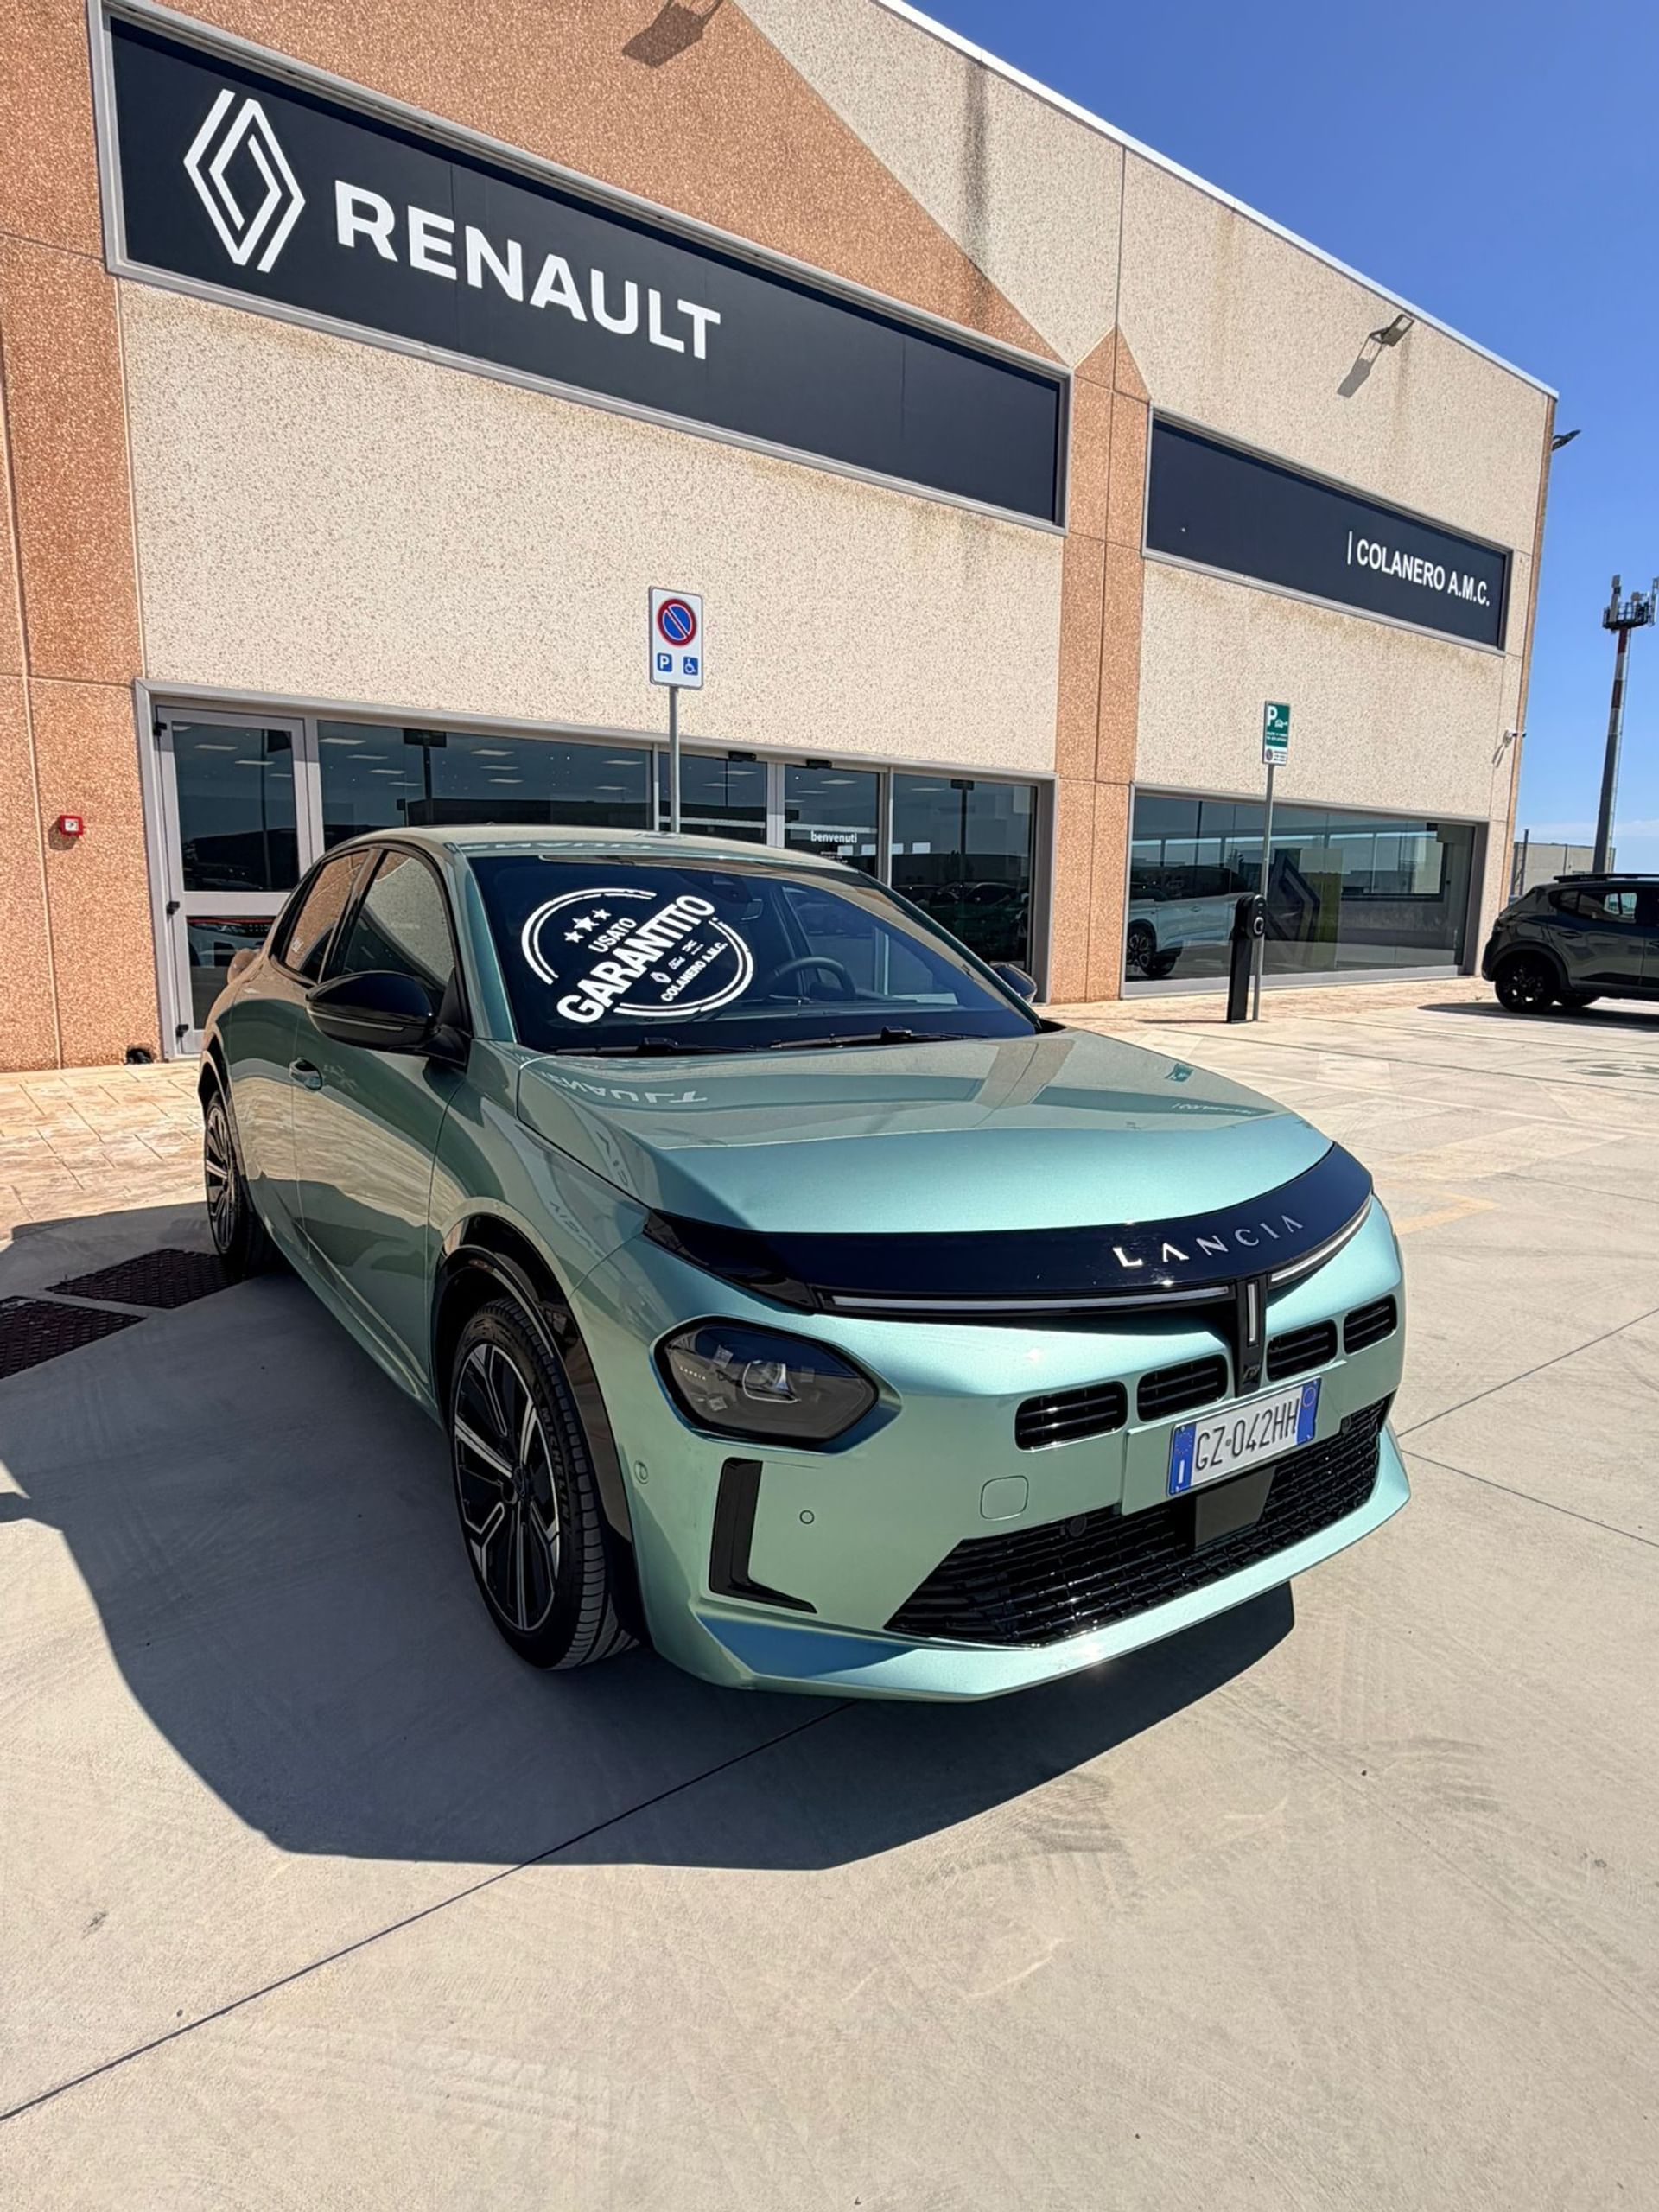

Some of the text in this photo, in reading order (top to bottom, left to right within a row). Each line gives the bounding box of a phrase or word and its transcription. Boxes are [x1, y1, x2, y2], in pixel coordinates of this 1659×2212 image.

[334, 180, 721, 359] RENAULT
[1357, 538, 1491, 607] COLANERO A.M.C.
[659, 655, 670, 670] P
[1268, 705, 1278, 727] P
[810, 830, 858, 844] benvenuti
[556, 894, 715, 1024] GARANTITO
[588, 918, 638, 953] USATO
[660, 960, 707, 1001] COLANERO
[1112, 1214, 1304, 1268] LANCIA
[542, 1408, 569, 1521] MICHELIN
